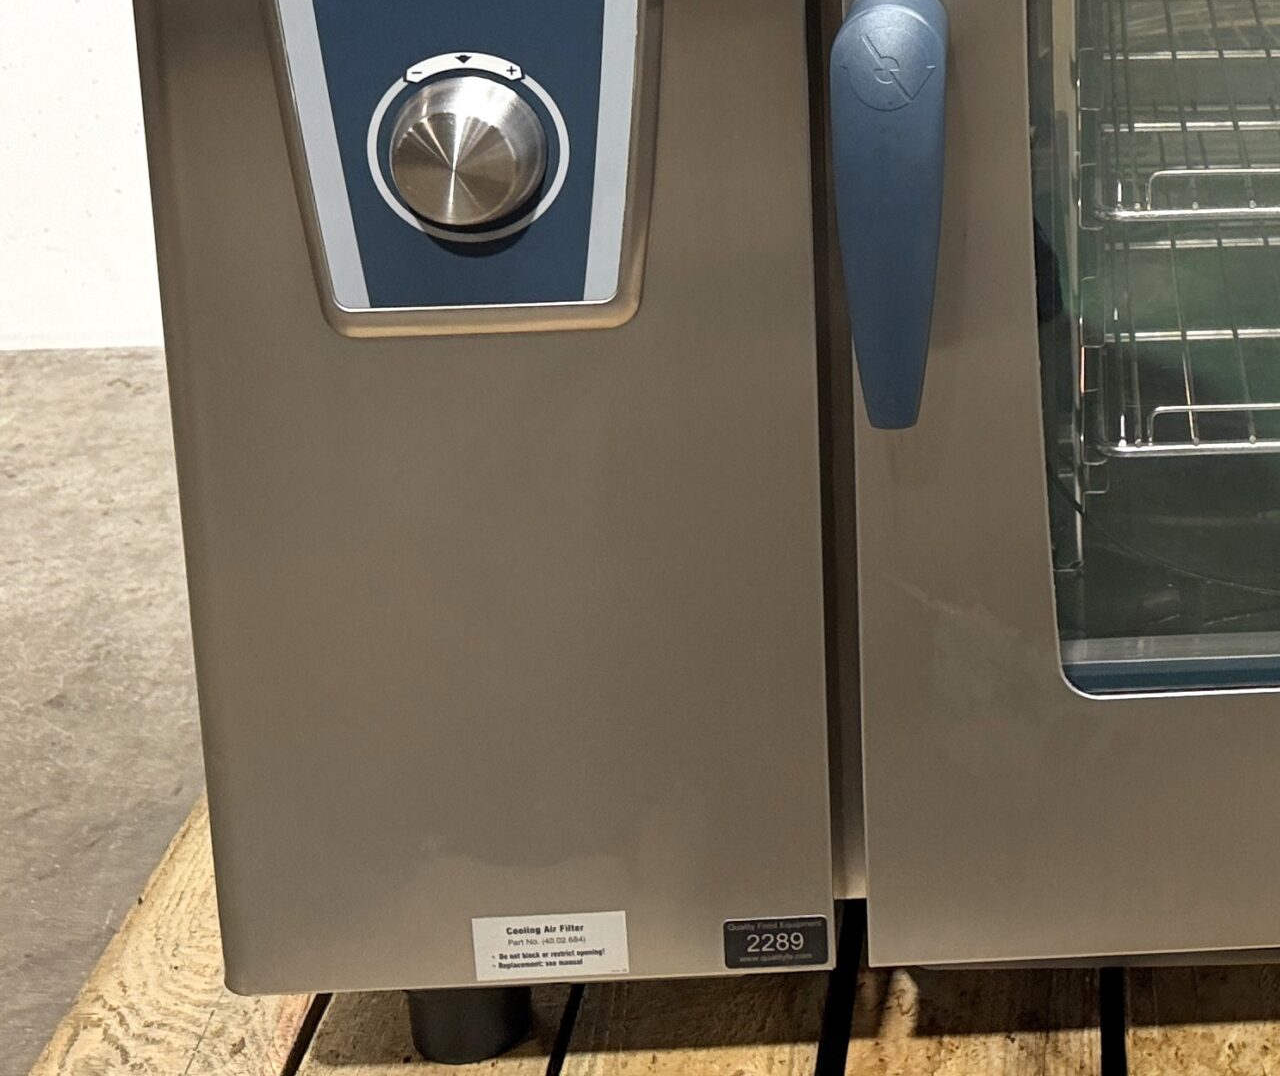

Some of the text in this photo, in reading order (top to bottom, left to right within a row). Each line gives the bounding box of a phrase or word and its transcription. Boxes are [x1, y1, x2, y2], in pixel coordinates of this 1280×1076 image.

[506, 924, 584, 935] Cooling Air Filter
[508, 938, 524, 946] Part
[746, 932, 804, 953] 2289
